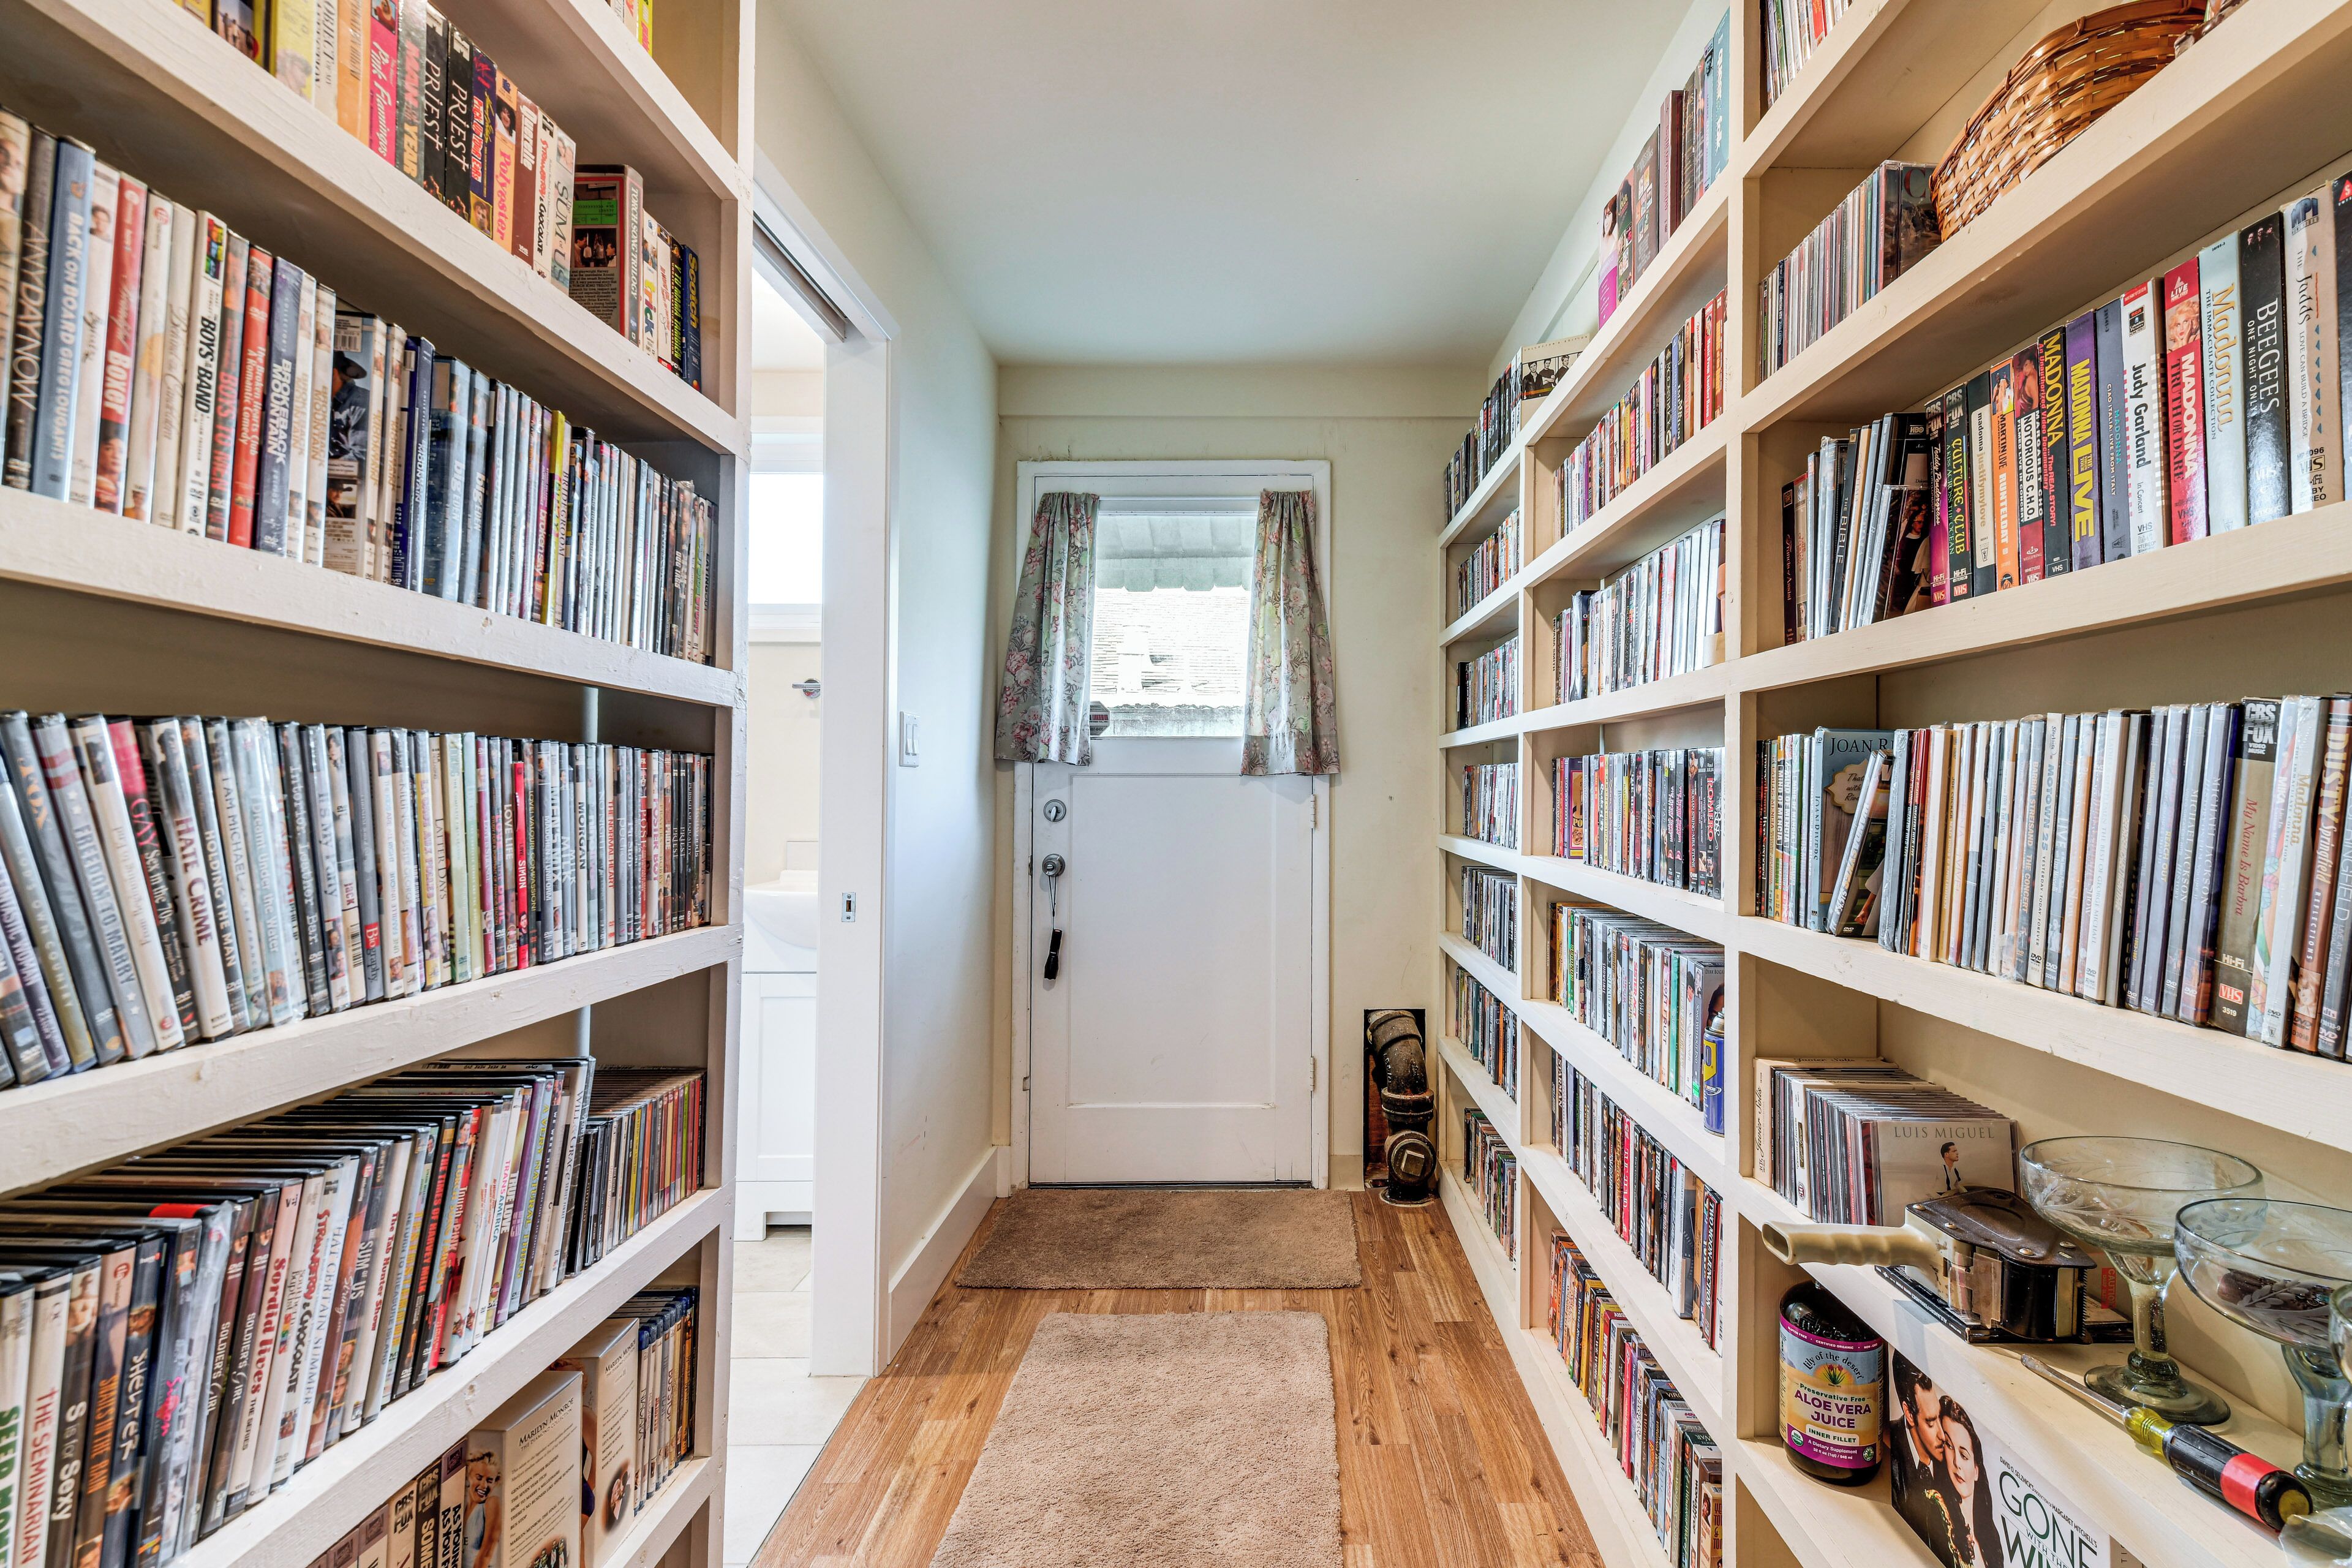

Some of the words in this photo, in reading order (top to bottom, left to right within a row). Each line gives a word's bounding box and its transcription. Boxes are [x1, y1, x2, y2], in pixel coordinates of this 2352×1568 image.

[372, 41, 389, 81] Pink
[405, 39, 420, 108] MAN
[374, 81, 392, 157] Flamingos
[424, 58, 443, 151] PRIEST
[450, 80, 469, 172] PRIEST
[404, 123, 418, 178] YEAR
[520, 105, 537, 171] Querelle
[496, 150, 511, 240] Polyester
[644, 279, 657, 337] trick
[688, 254, 699, 329] Scotch
[2206, 309, 2215, 376] IMMACULATE
[2211, 281, 2238, 432] Madonna
[2247, 346, 2256, 382] NIGHT
[2043, 331, 2065, 448] MADONNA
[2070, 358, 2092, 447] MADONNA
[2128, 363, 2147, 401] Judy
[2169, 358, 2182, 413] TRUTH
[2249, 385, 2258, 417] ONLY
[1910, 425, 1924, 434] HBO
[2172, 416, 2182, 434] OR
[2180, 354, 2200, 480] MADONNA
[2208, 377, 2217, 440] COLLECTION
[1931, 443, 1941, 472] Teddy
[2023, 415, 2034, 483] NOTORIOUS
[2113, 408, 2122, 465] MADONNA
[2132, 404, 2151, 469] Garland
[2173, 435, 2185, 483] DARE
[1951, 438, 1964, 508] CULTURE
[1976, 451, 1986, 527] justifymylove
[2136, 481, 2143, 490] In
[559, 470, 569, 557] BRIDEGROOM
[1999, 472, 2008, 544] RUNTELDAT
[2027, 484, 2036, 520] C.H.O.
[1838, 515, 1847, 564] BIBLE
[1953, 514, 1965, 554] CLUB
[2137, 522, 2154, 532] VHS
[1953, 584, 1967, 596] VHS
[2052, 563, 2063, 572] VHS
[1934, 589, 1946, 601] VHS
[1830, 737, 1872, 756] JOAN
[2044, 763, 2055, 829] MOTOWN
[2318, 731, 2347, 824] DUSTY
[503, 803, 513, 833] LOVE
[2246, 797, 2258, 817] My
[2289, 774, 2310, 846] Madonna
[435, 818, 447, 865] LATTER
[505, 834, 514, 860] LIFE
[578, 802, 586, 870] MORGAN
[2041, 831, 2049, 851] 25
[2241, 820, 2256, 859] Name
[2316, 820, 2336, 886] Springfield
[173, 816, 199, 875] HATE
[186, 877, 213, 947] CRIME
[437, 867, 448, 900] DAYS
[2241, 860, 2252, 872] Is
[2234, 872, 2250, 916] Barbra
[2306, 891, 2321, 960] REFLECTIONS
[2220, 984, 2243, 1003] VHS
[2222, 1006, 2237, 1017] 3519
[1894, 1125, 1929, 1139] LUIS
[1935, 1125, 1996, 1140] MIGUEL
[385, 1234, 395, 1254] Tab
[389, 1211, 399, 1232] The
[377, 1256, 391, 1298] Hunter
[371, 1300, 384, 1332] Show
[1803, 1356, 1815, 1370] Lily
[1815, 1351, 1825, 1361] of
[1825, 1352, 1840, 1362] the
[1842, 1357, 1862, 1379] desert
[35, 1387, 59, 1431] THE
[120, 1348, 148, 1462] SHELTER
[1794, 1389, 1832, 1412] ALOE
[1835, 1403, 1872, 1414] VERA
[1800, 1383, 1848, 1401] Preservative
[519, 1419, 548, 1446] MARILYN
[549, 1397, 574, 1421] MONROE
[1809, 1428, 1830, 1440] INNER
[1833, 1434, 1856, 1443] FILLET
[1811, 1411, 1855, 1428] JUICE
[1812, 1441, 1830, 1451] Dietary
[1830, 1445, 1857, 1455] Supplement
[20, 1431, 48, 1566] SEMINARIAN
[1999, 1471, 2097, 1568] GONE
[2052, 1503, 2073, 1526] MARGARET
[2074, 1521, 2097, 1548] MITCHELL'S
